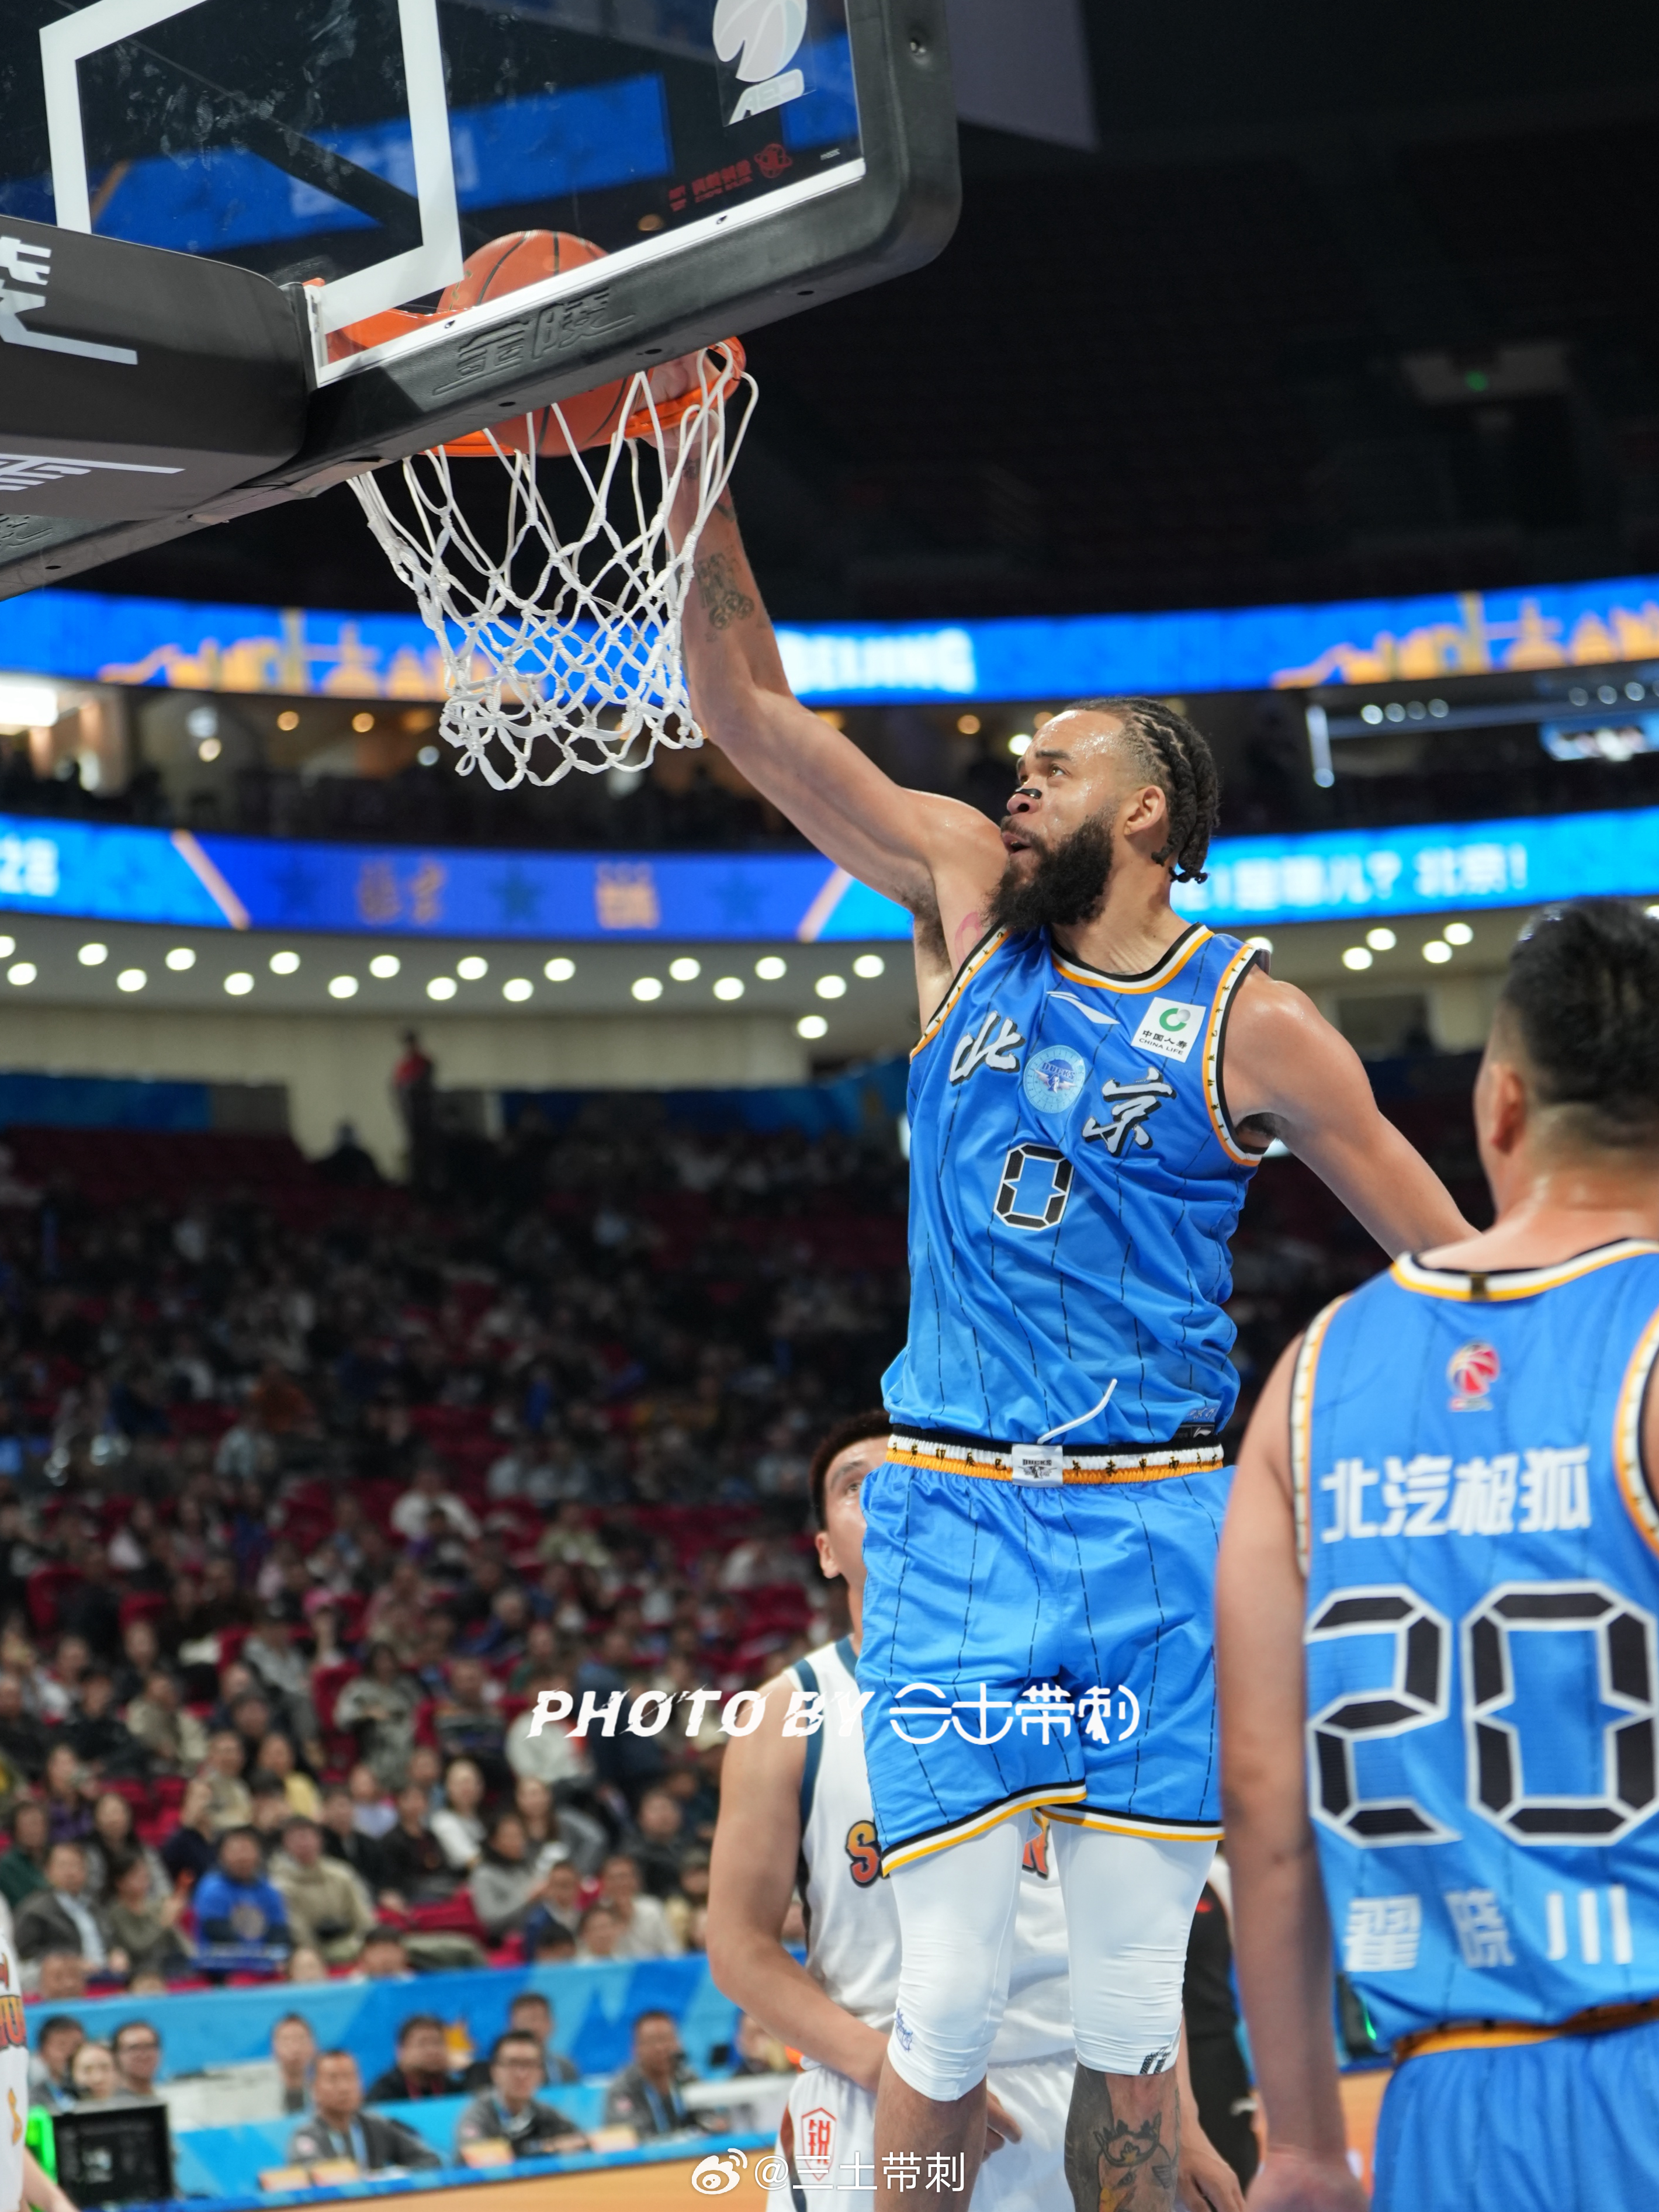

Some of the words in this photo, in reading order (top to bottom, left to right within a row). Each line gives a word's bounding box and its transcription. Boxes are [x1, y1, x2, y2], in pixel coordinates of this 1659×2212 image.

[950, 1011, 1177, 1156] 北京
[1041, 1062, 1075, 1081] DUCKS
[1139, 1038, 1163, 1049] CHINA
[1166, 1046, 1184, 1055] LIFE
[1142, 1030, 1188, 1049] 中国人寿
[993, 1142, 1075, 1231] 0
[1319, 1445, 1592, 1544] 北汽极狐
[1305, 1580, 1659, 1849] 20
[1343, 1884, 1633, 1972] 翟晓川
